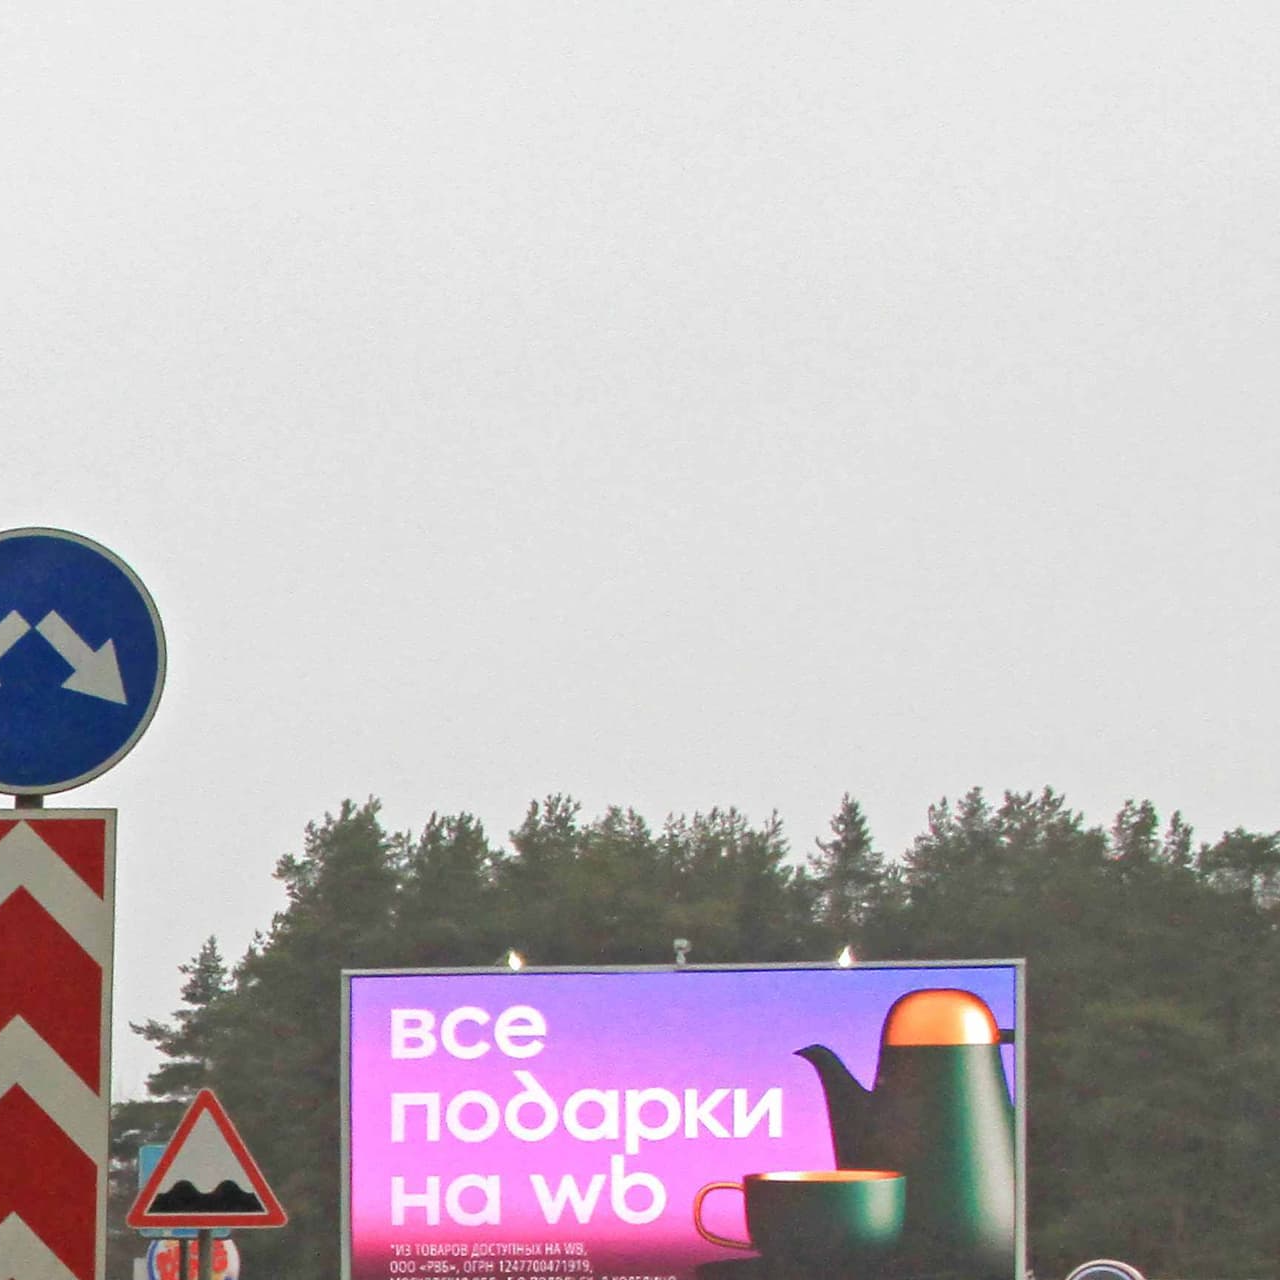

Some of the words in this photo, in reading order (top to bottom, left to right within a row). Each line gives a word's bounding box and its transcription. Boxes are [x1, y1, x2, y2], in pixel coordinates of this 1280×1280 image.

[391, 1005, 547, 1060] все
[391, 1070, 783, 1155] подарки
[391, 1174, 501, 1227] на
[529, 1154, 667, 1225] wb
[389, 1260, 416, 1274] ООО
[463, 1260, 495, 1274] ОГРН
[415, 1242, 468, 1257] ТОВАРОВ
[470, 1242, 542, 1258] ДОСТУПНЫХ
[544, 1242, 562, 1256] НА
